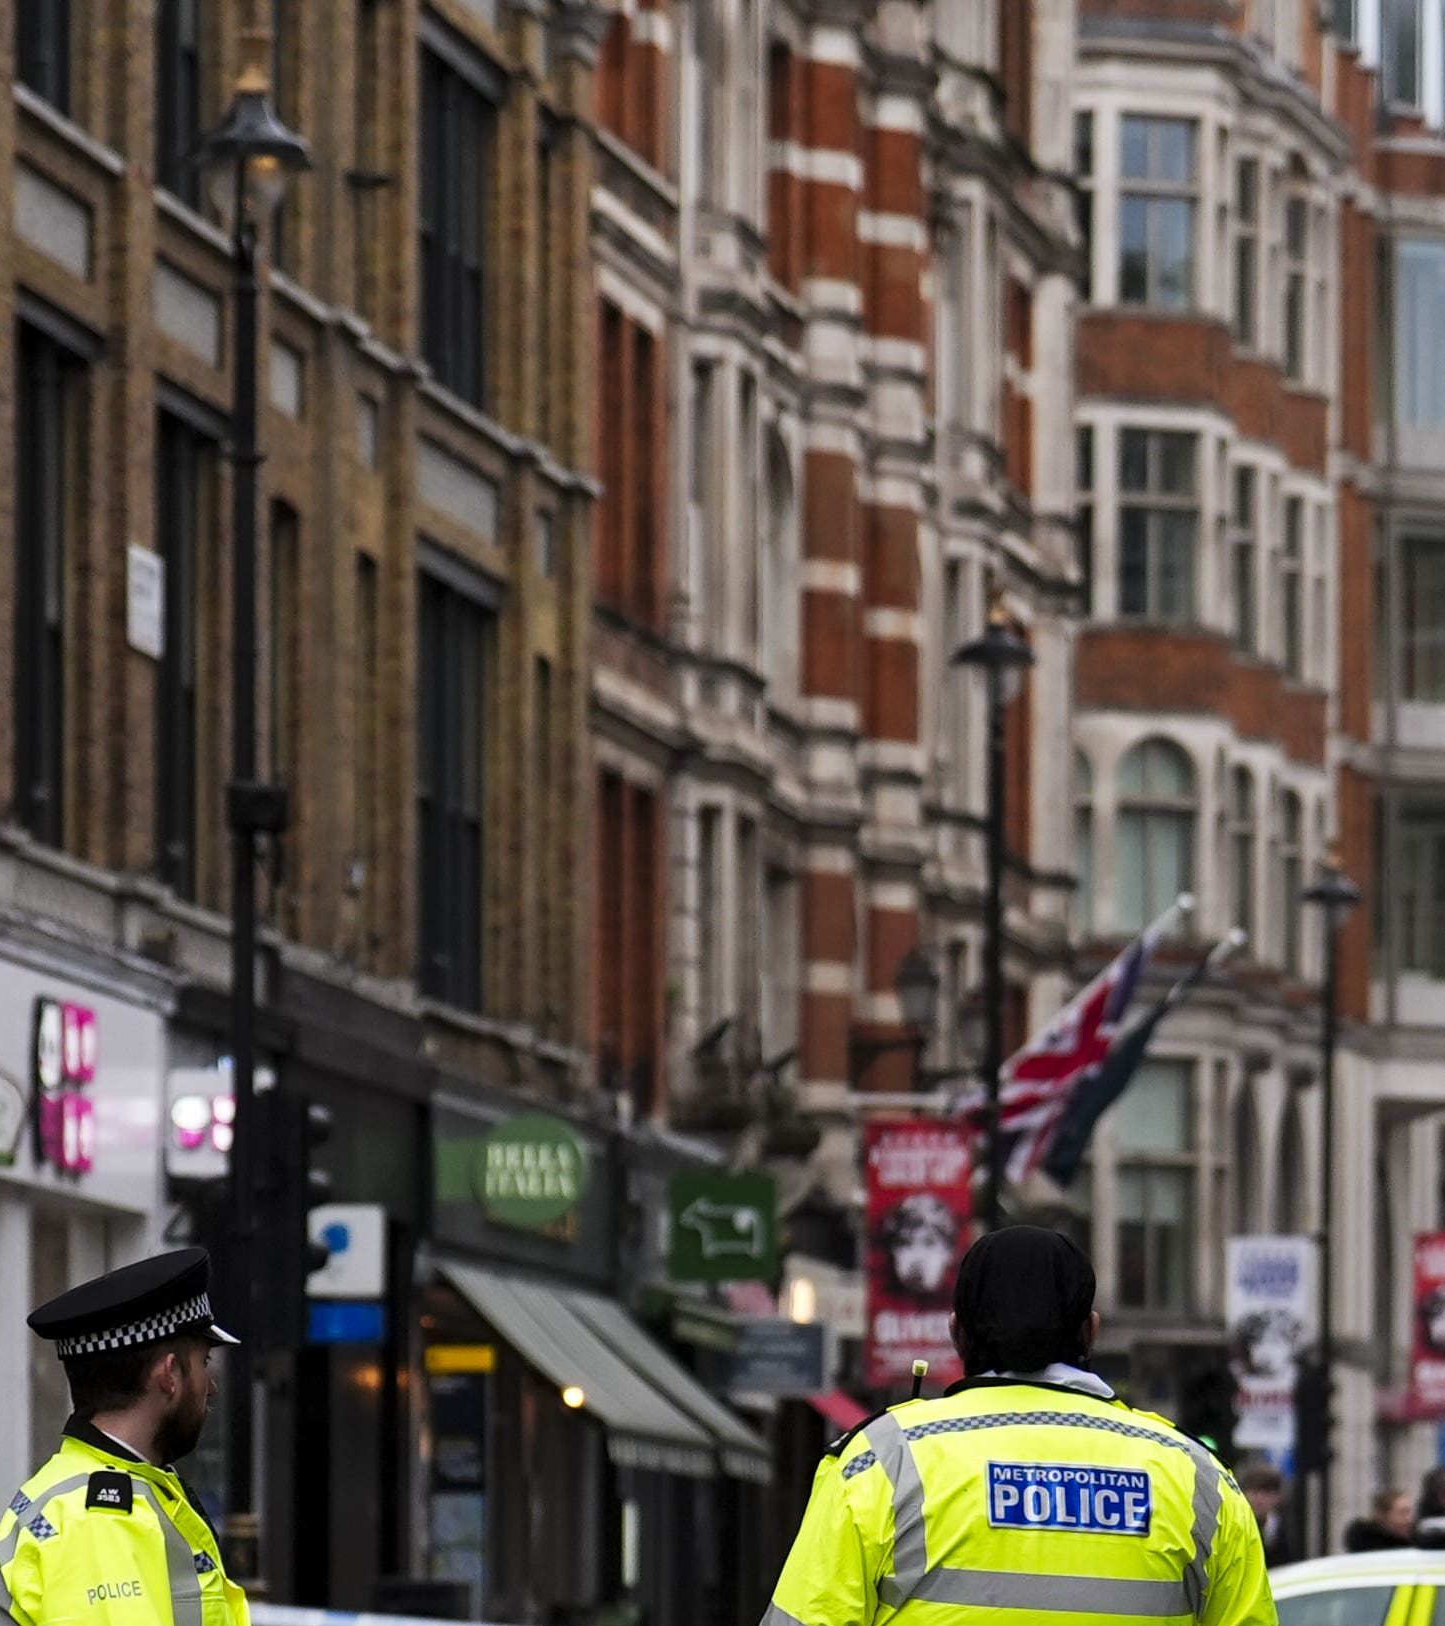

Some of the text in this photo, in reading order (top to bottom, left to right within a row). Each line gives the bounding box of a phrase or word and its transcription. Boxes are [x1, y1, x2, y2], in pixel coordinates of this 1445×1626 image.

[993, 1467, 1145, 1488] METROPOLITAN
[994, 1484, 1146, 1528] POLICE
[87, 1580, 142, 1605] POLICE
